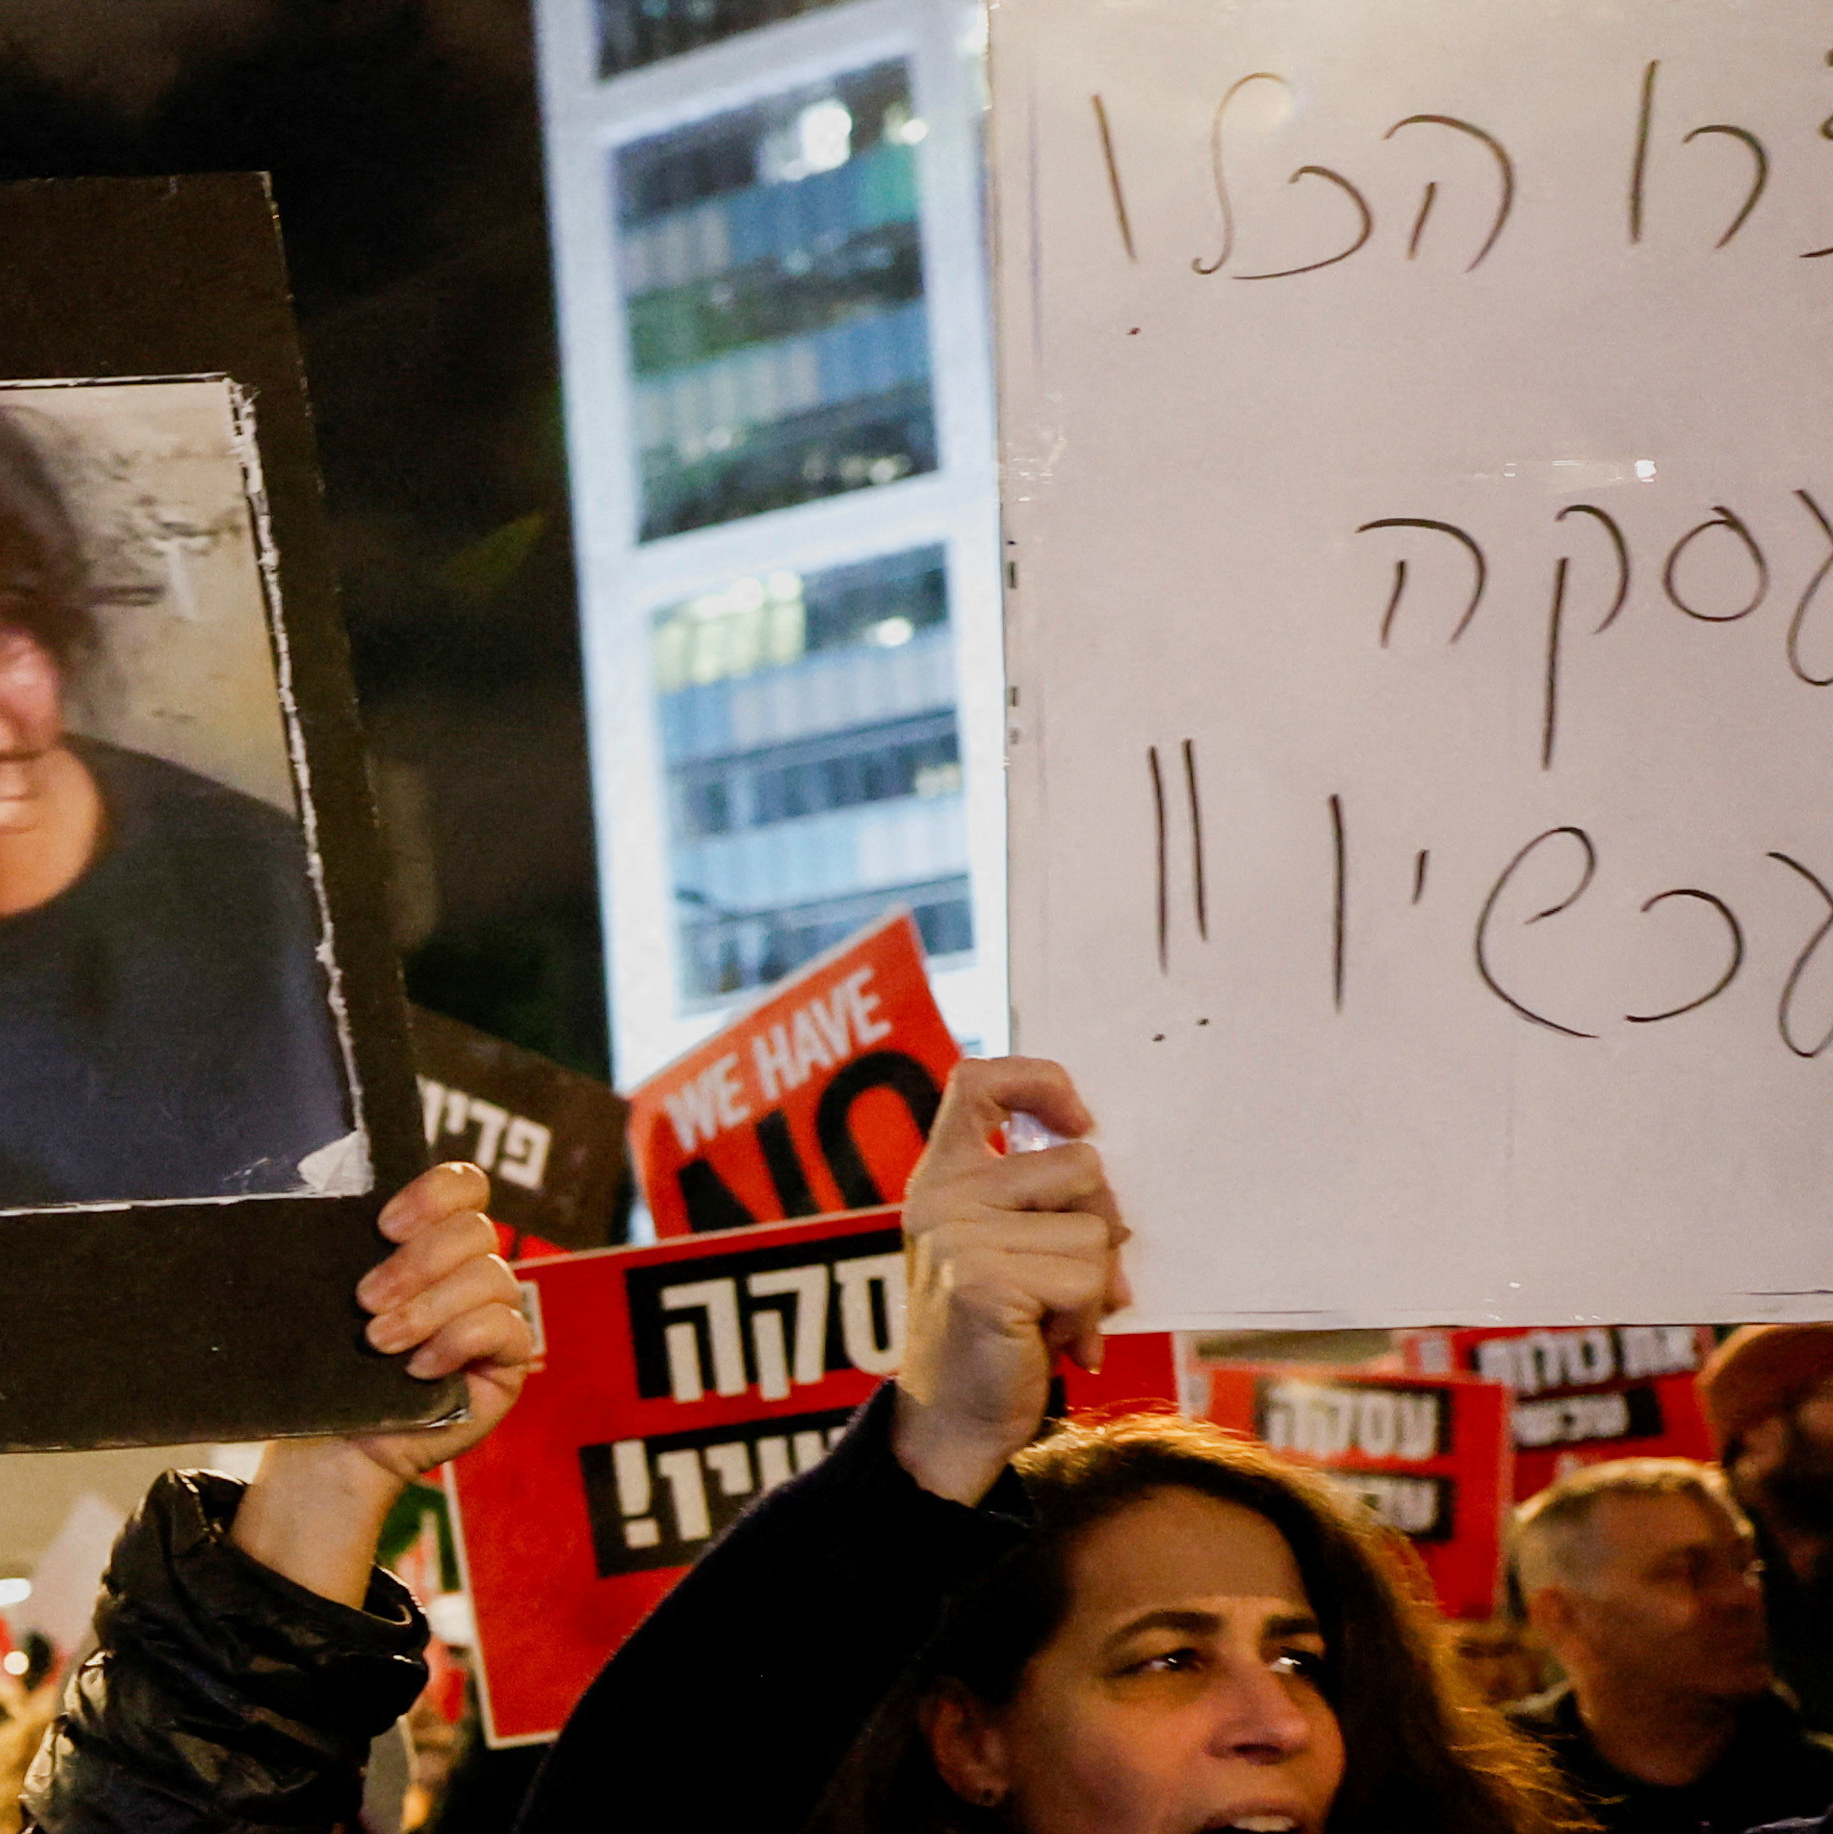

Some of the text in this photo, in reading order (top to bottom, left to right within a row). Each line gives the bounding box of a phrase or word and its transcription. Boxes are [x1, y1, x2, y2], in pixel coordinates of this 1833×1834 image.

[664, 966, 893, 1155] WE HAVE
[661, 1252, 907, 1402] סקה
